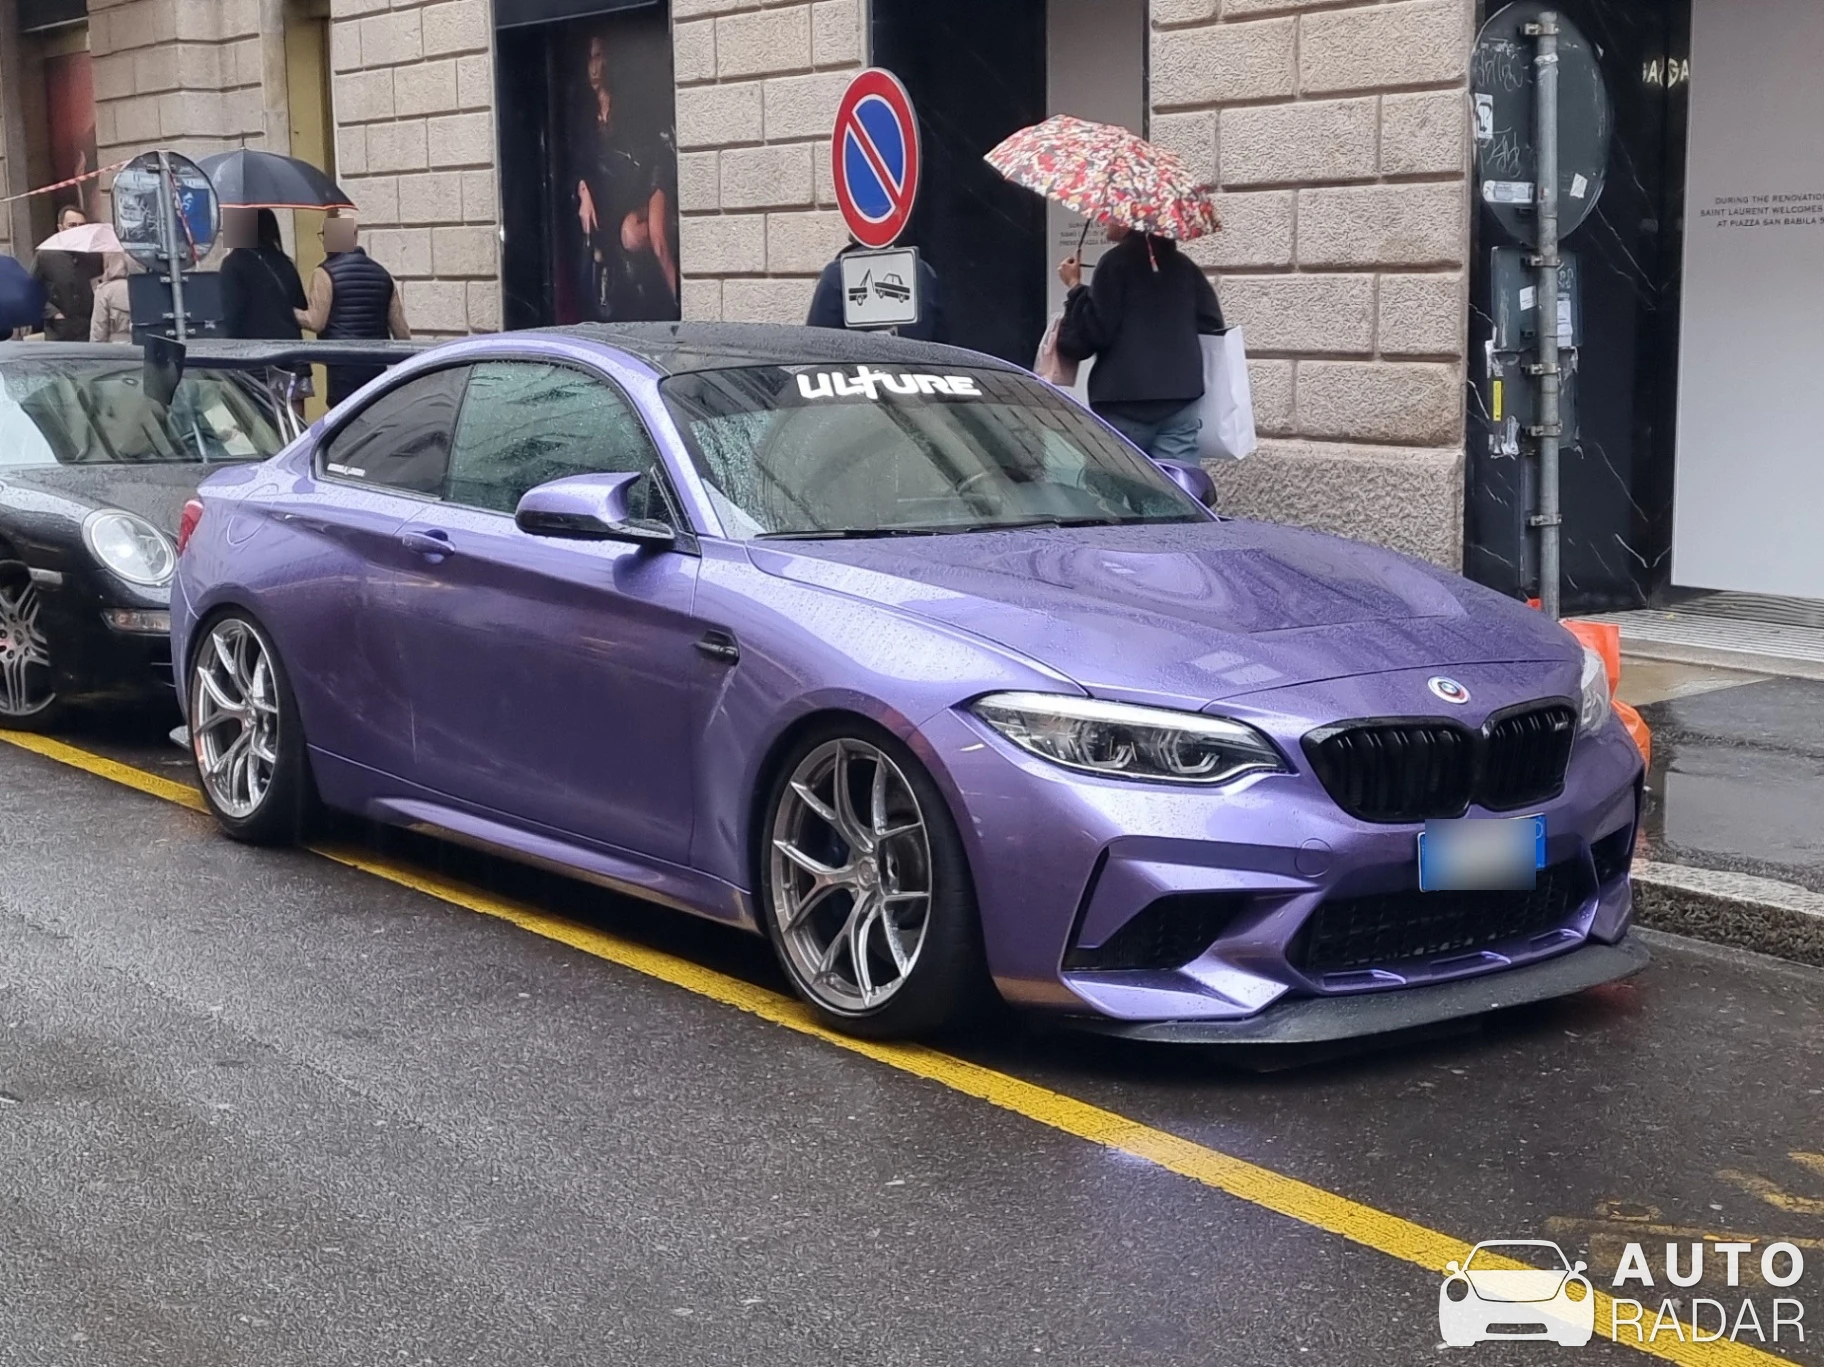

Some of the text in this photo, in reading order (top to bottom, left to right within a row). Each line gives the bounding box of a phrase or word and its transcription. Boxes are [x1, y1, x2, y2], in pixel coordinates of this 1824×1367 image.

[1715, 193, 1824, 205] DURING THE RENOVATIO
[1700, 204, 1823, 217] SAINT LAURENT WELCOMES
[1717, 219, 1727, 227] AT
[1730, 218, 1760, 227] PIAZZA
[1763, 218, 1781, 226] SAN
